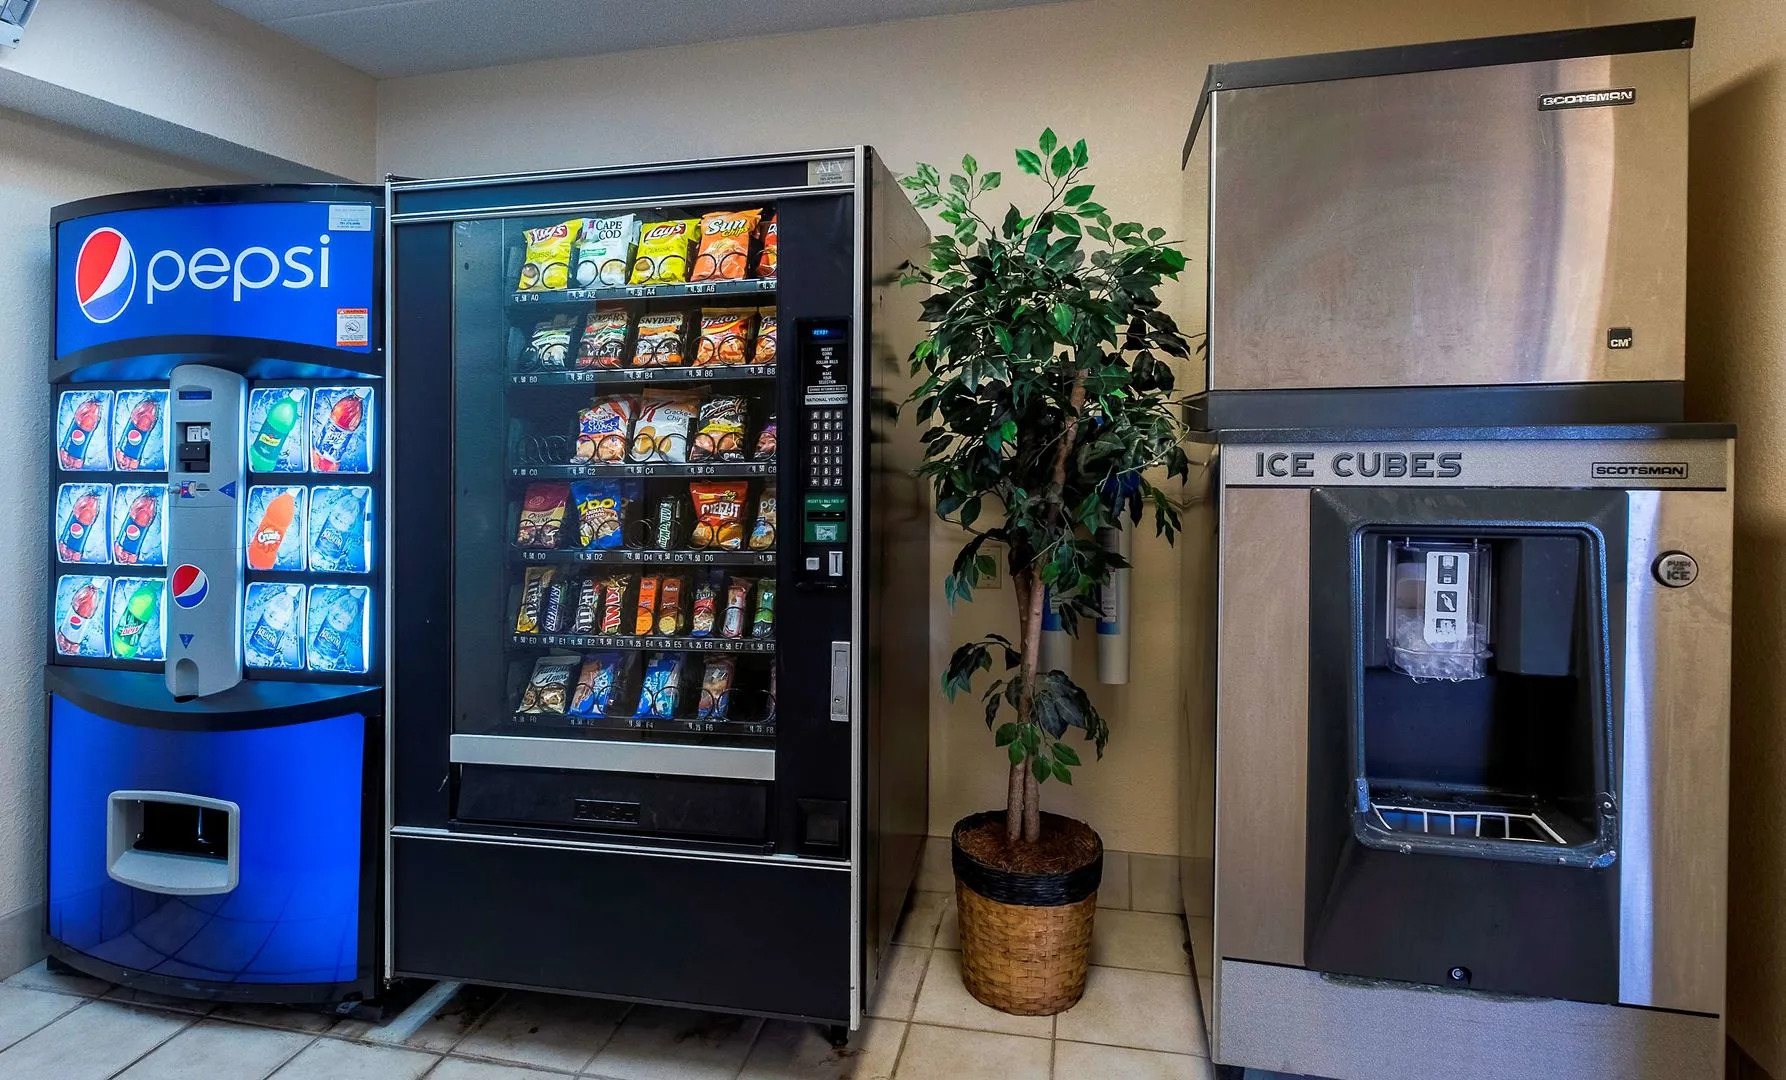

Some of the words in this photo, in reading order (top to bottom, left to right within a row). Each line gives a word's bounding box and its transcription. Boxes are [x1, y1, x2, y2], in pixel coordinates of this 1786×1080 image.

[1543, 90, 1633, 106] SCOTSMAN
[596, 220, 622, 230] CAPE
[704, 219, 747, 236] Sun
[598, 230, 622, 240] COD
[147, 234, 330, 305] pepsi
[1255, 452, 1314, 478] ICE
[1331, 452, 1462, 478] CUBES
[1596, 466, 1684, 475] SCOTSMAN
[577, 498, 615, 515] ZOO
[259, 530, 280, 544] Crush
[1667, 570, 1690, 580] ICE
[603, 586, 620, 630] TWIX
